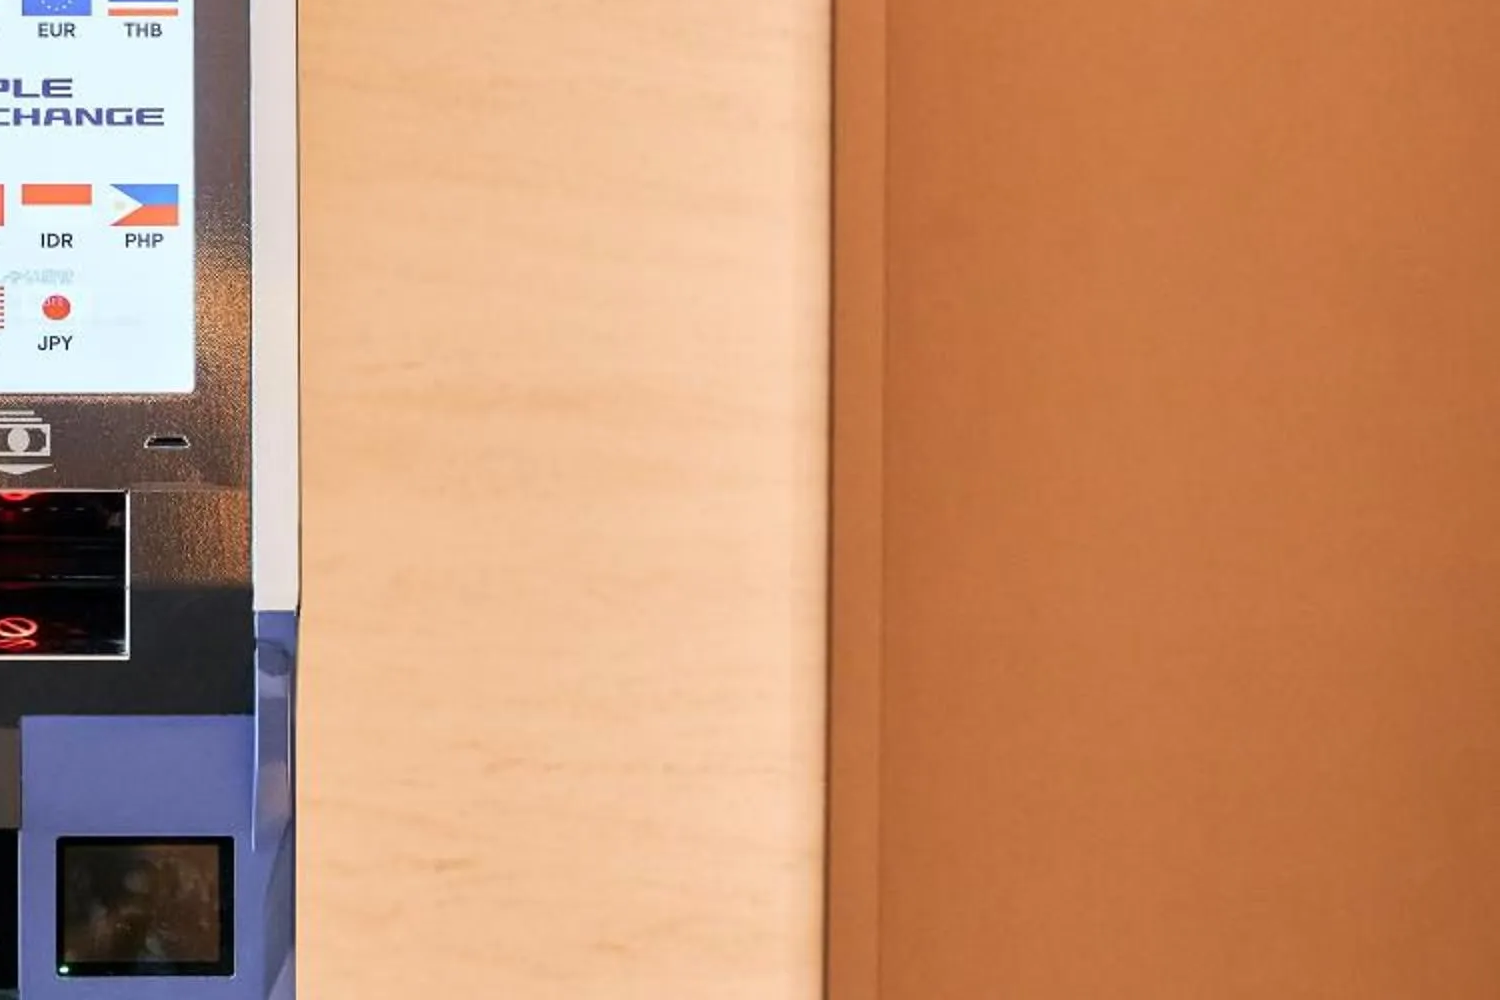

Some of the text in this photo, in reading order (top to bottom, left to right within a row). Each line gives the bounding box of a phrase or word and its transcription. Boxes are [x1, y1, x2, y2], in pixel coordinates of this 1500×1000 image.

[38, 23, 76, 38] EUR
[124, 23, 163, 38] THB
[41, 233, 73, 248] IDR
[125, 233, 164, 248] PHP
[38, 336, 73, 352] JPY
